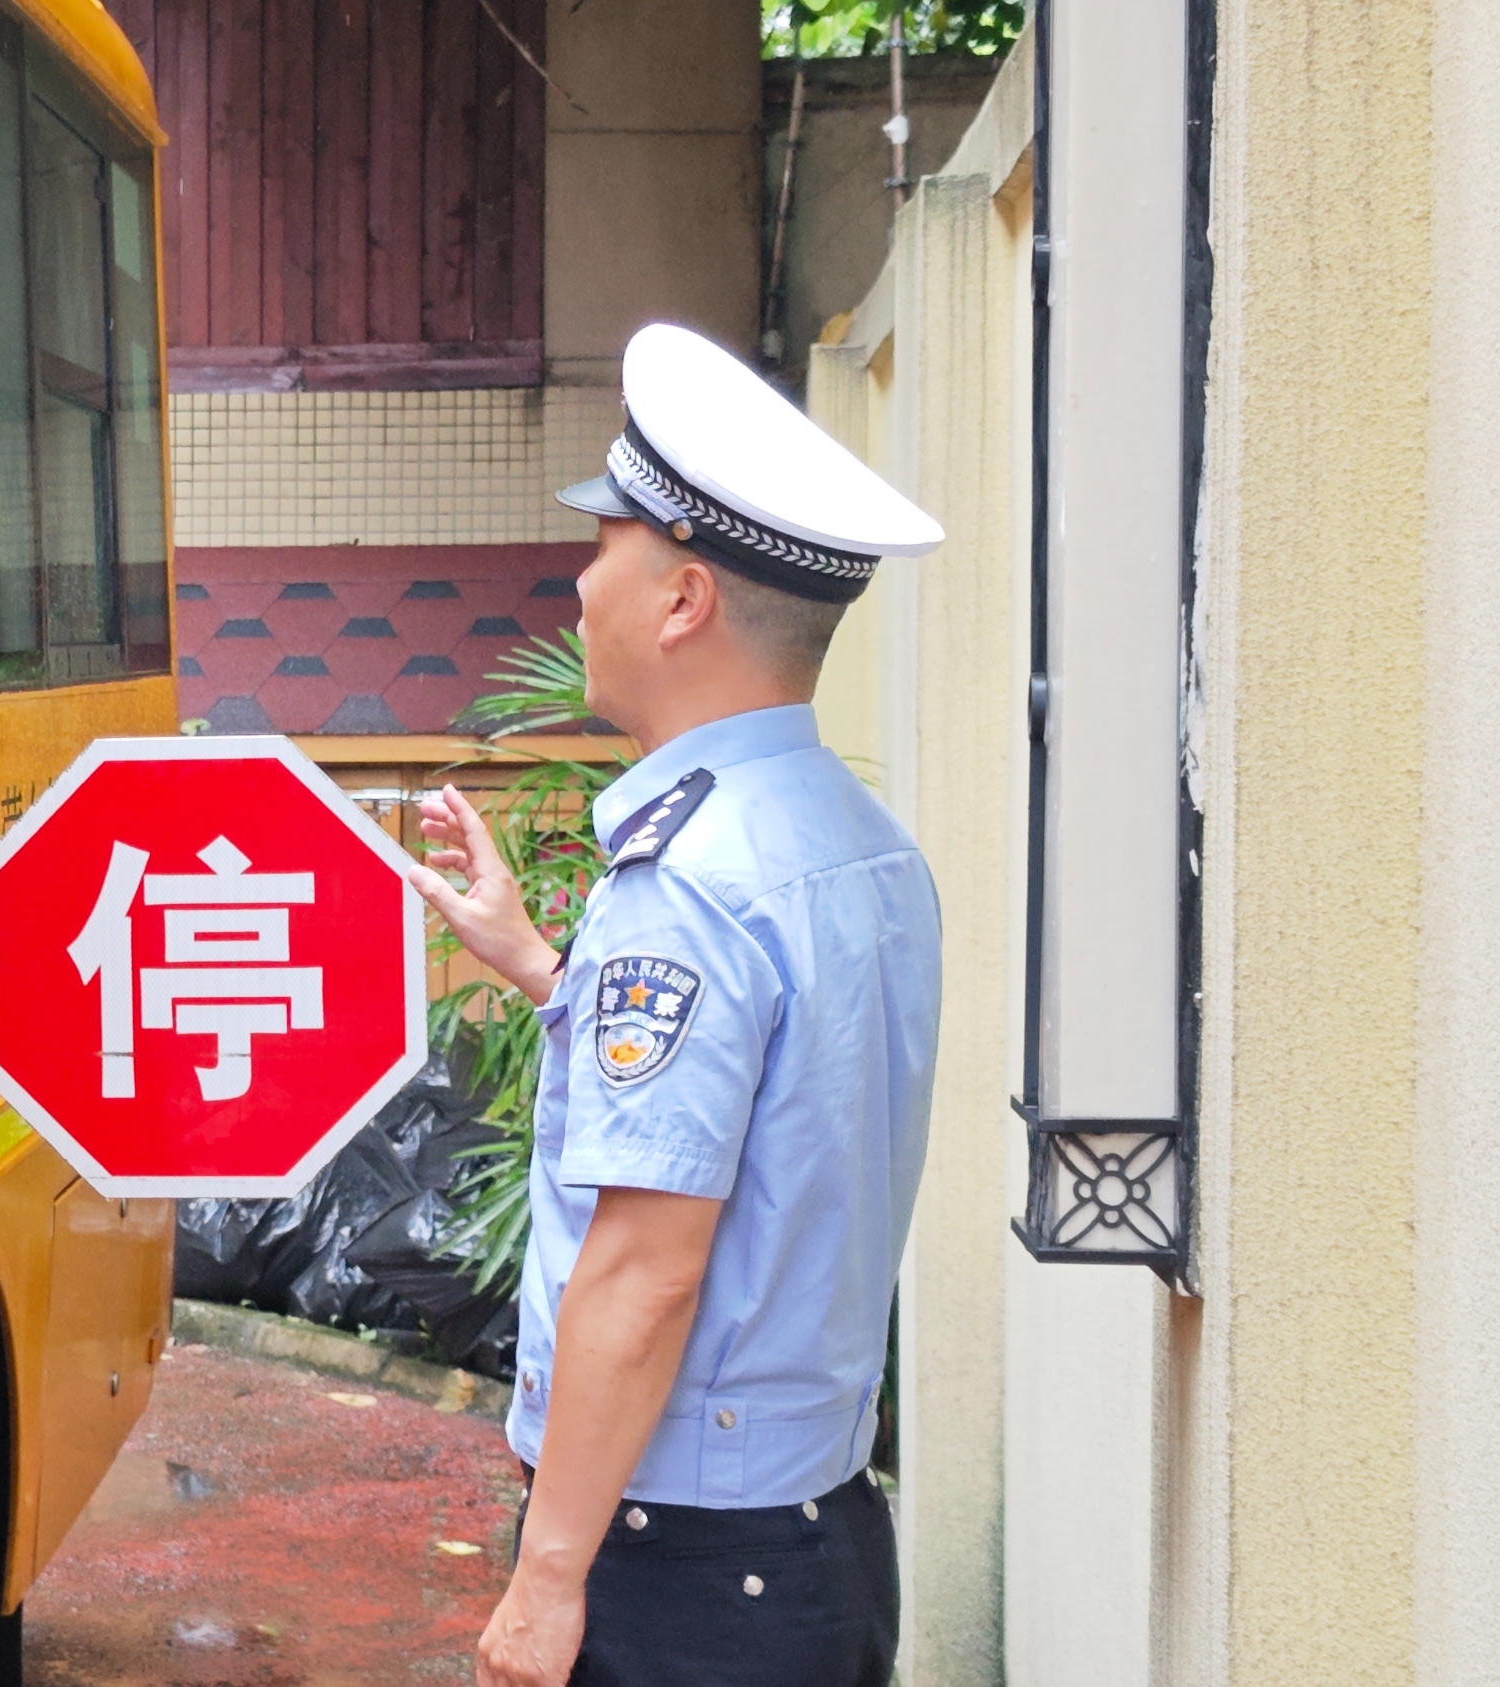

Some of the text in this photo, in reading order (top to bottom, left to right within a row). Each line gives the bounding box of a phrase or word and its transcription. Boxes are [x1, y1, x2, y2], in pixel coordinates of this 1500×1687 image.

[67, 834, 324, 1102] 停
[602, 959, 697, 997] 中华人民共和国
